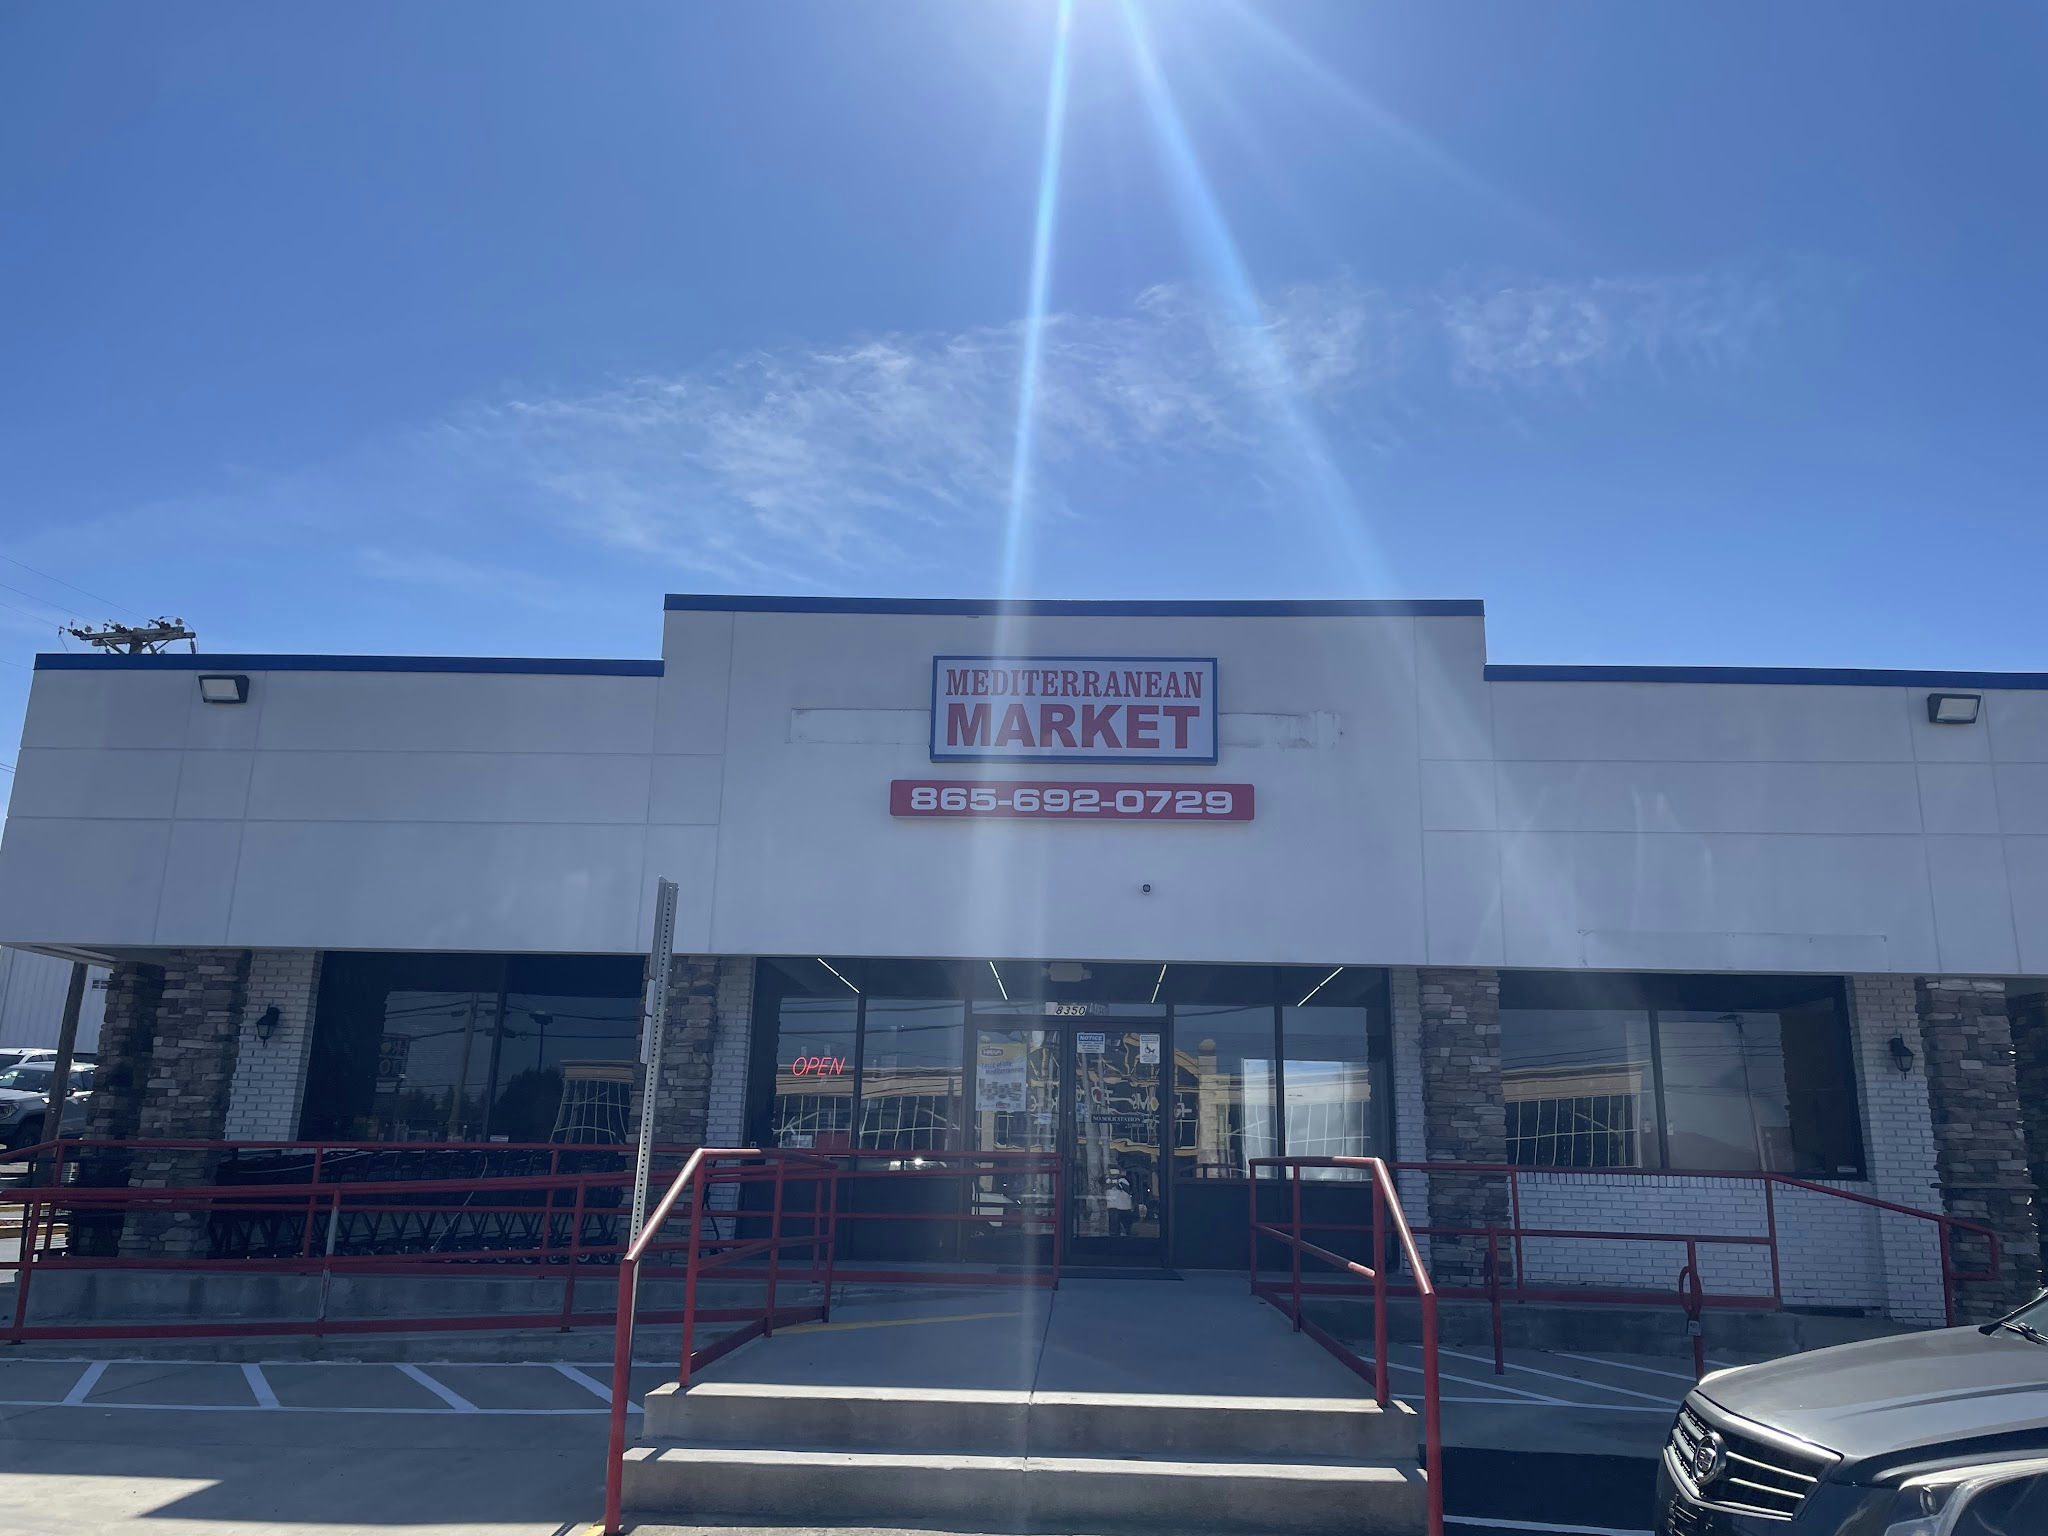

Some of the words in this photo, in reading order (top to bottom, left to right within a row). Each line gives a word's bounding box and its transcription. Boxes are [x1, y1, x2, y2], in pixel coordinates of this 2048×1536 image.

[945, 669, 1203, 699] MEDITERRANEAN
[946, 703, 1201, 749] MARKET
[910, 786, 1233, 815] 865-692-0729
[1056, 1006, 1086, 1016] 8350
[792, 1056, 846, 1077] OPEN
